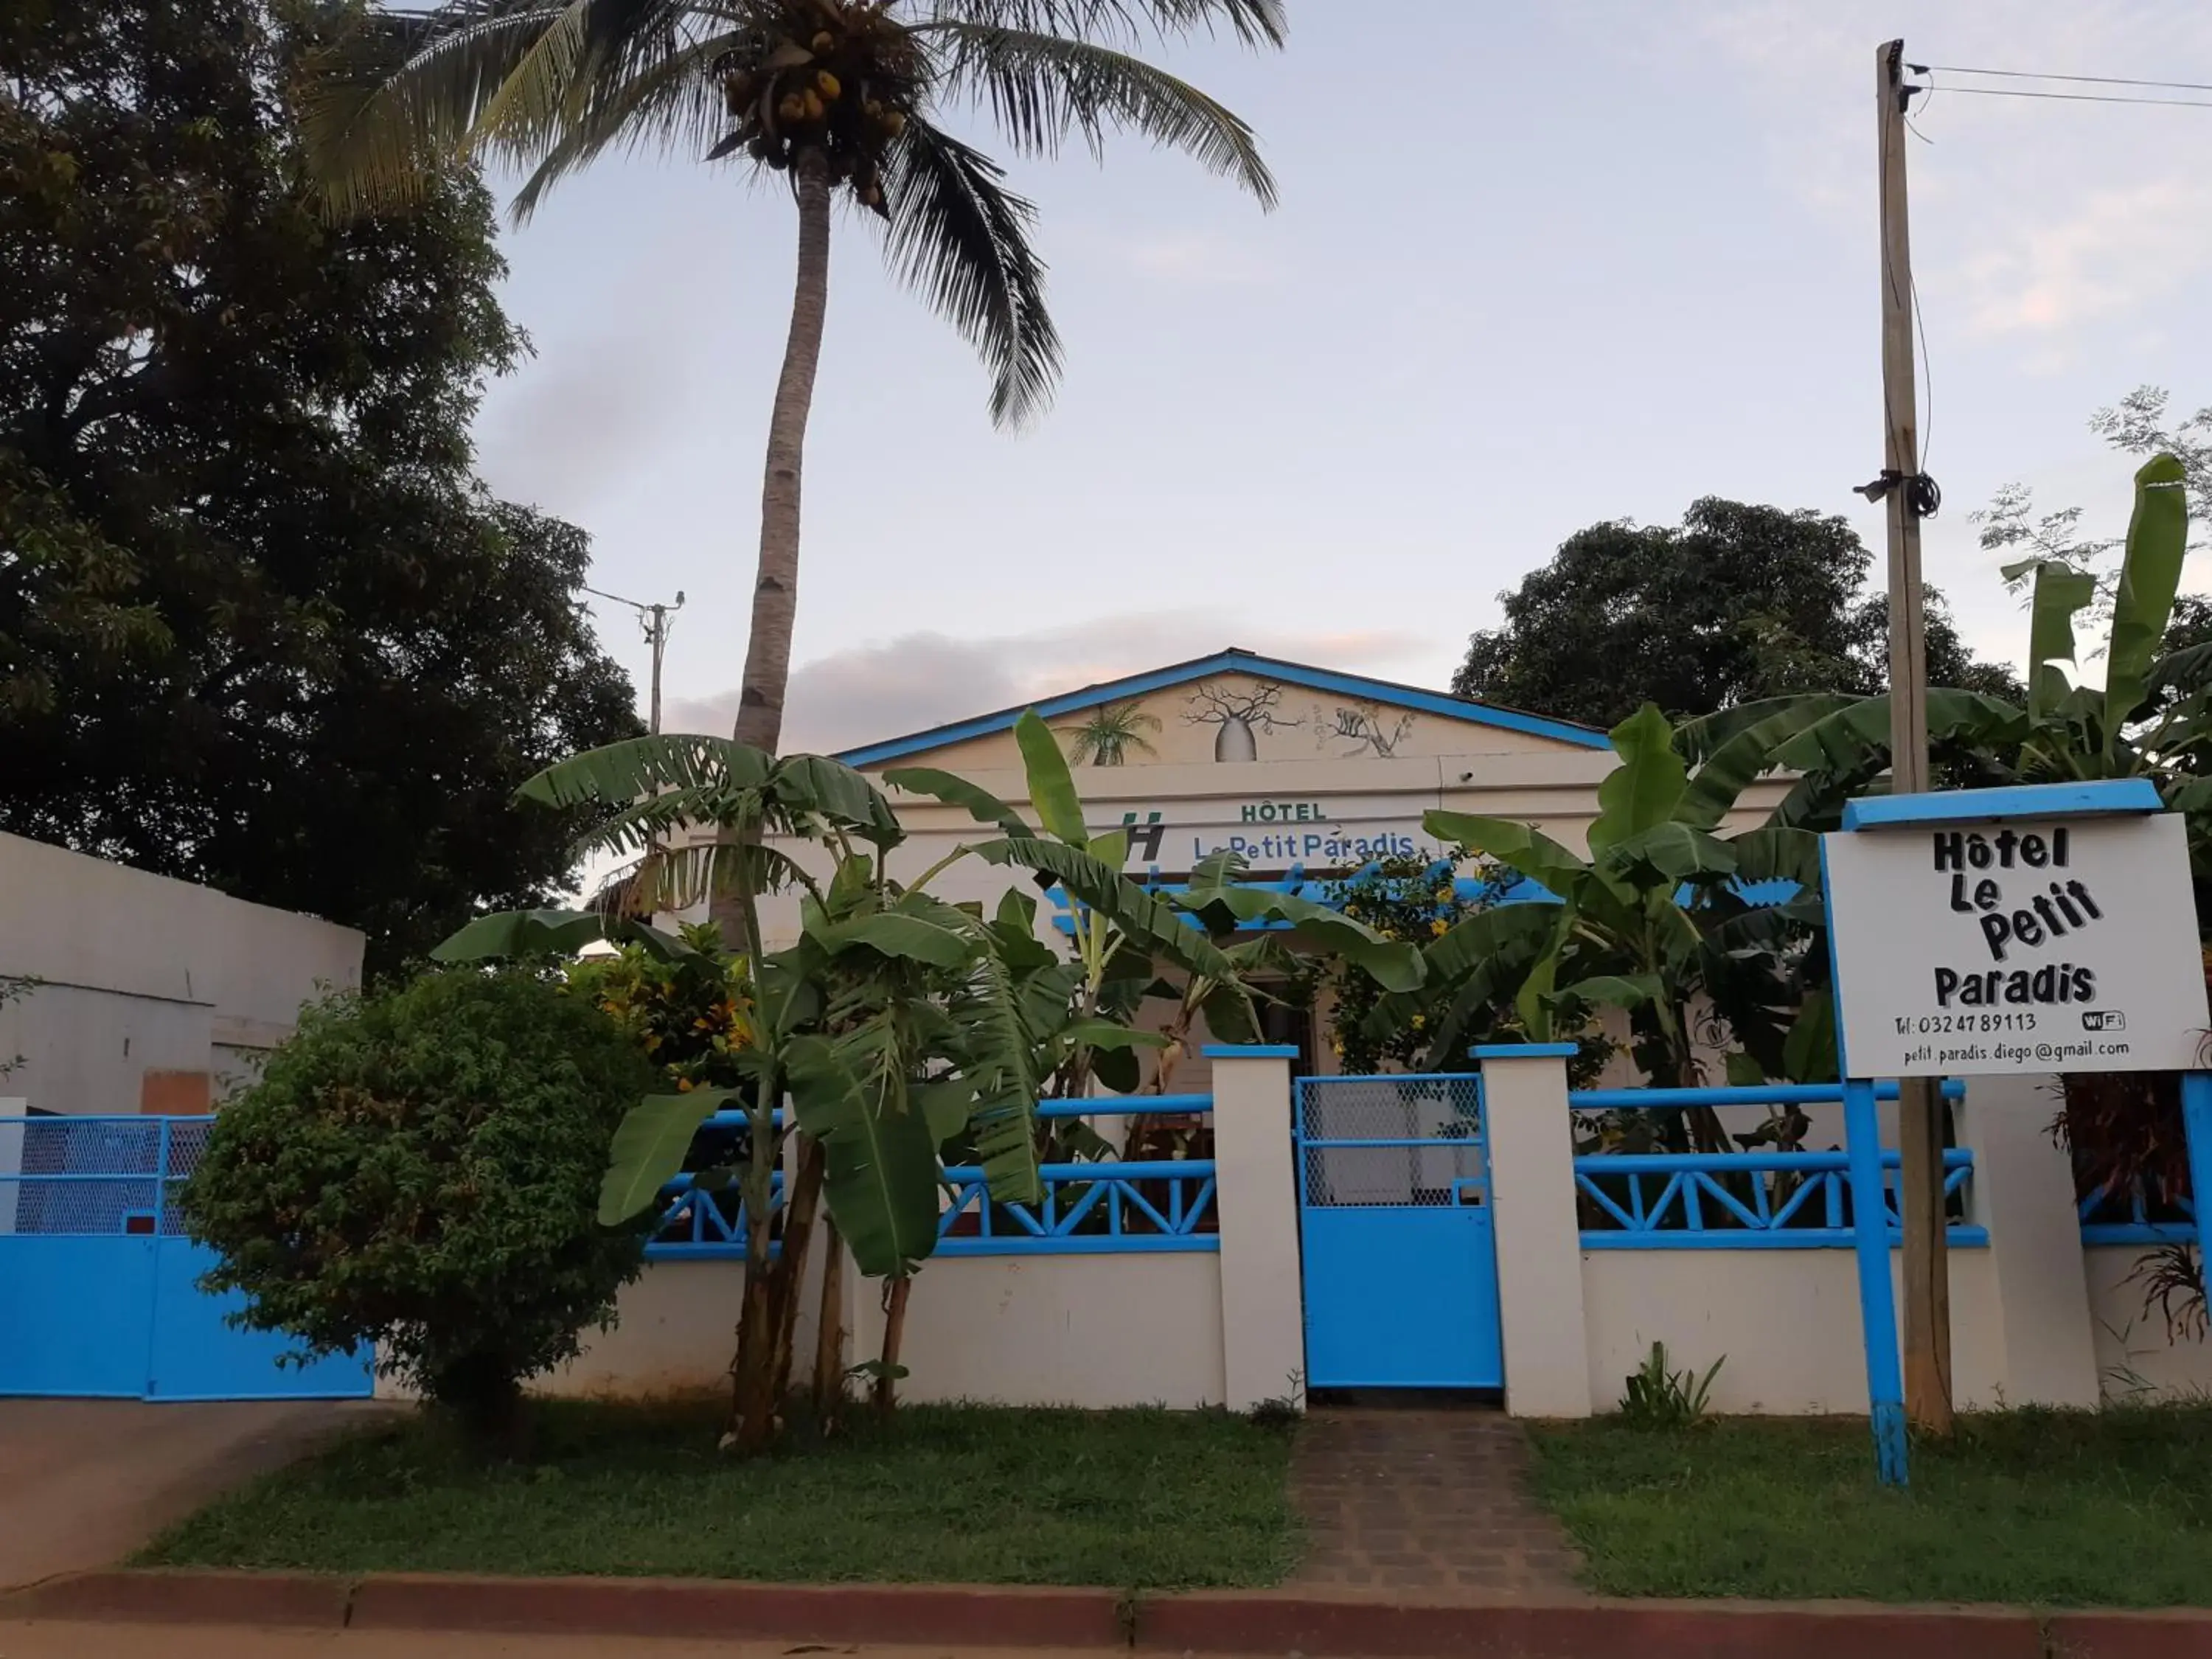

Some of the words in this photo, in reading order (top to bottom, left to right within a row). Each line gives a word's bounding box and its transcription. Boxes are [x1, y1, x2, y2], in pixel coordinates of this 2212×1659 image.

[1241, 800, 1326, 823] HÔTEL
[1304, 832, 1414, 858] Paradis
[1933, 827, 2070, 873] Hôtel
[1950, 874, 2000, 913] Le
[1934, 962, 2098, 1008] Paradis
